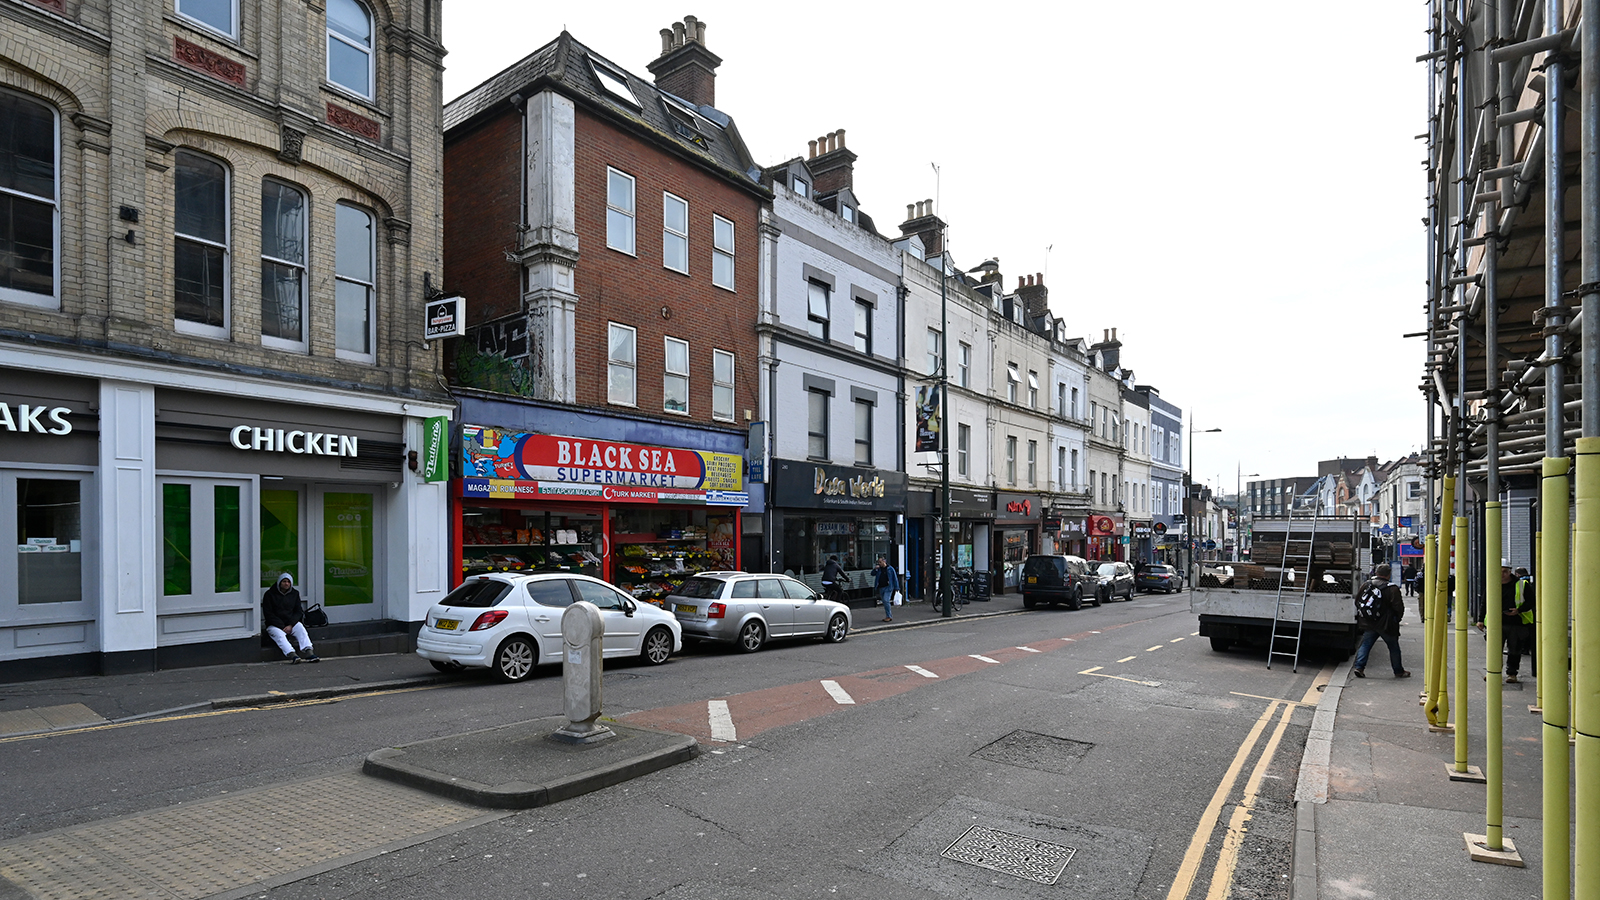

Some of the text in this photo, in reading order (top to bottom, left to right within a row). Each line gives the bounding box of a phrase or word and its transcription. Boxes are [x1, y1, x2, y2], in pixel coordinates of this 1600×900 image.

[0, 402, 72, 435] AKS
[229, 425, 358, 457] CHICKEN
[557, 441, 677, 472] BLACK SEA
[467, 484, 497, 492] MAGAZIN
[557, 467, 676, 487] SUPERMARKET
